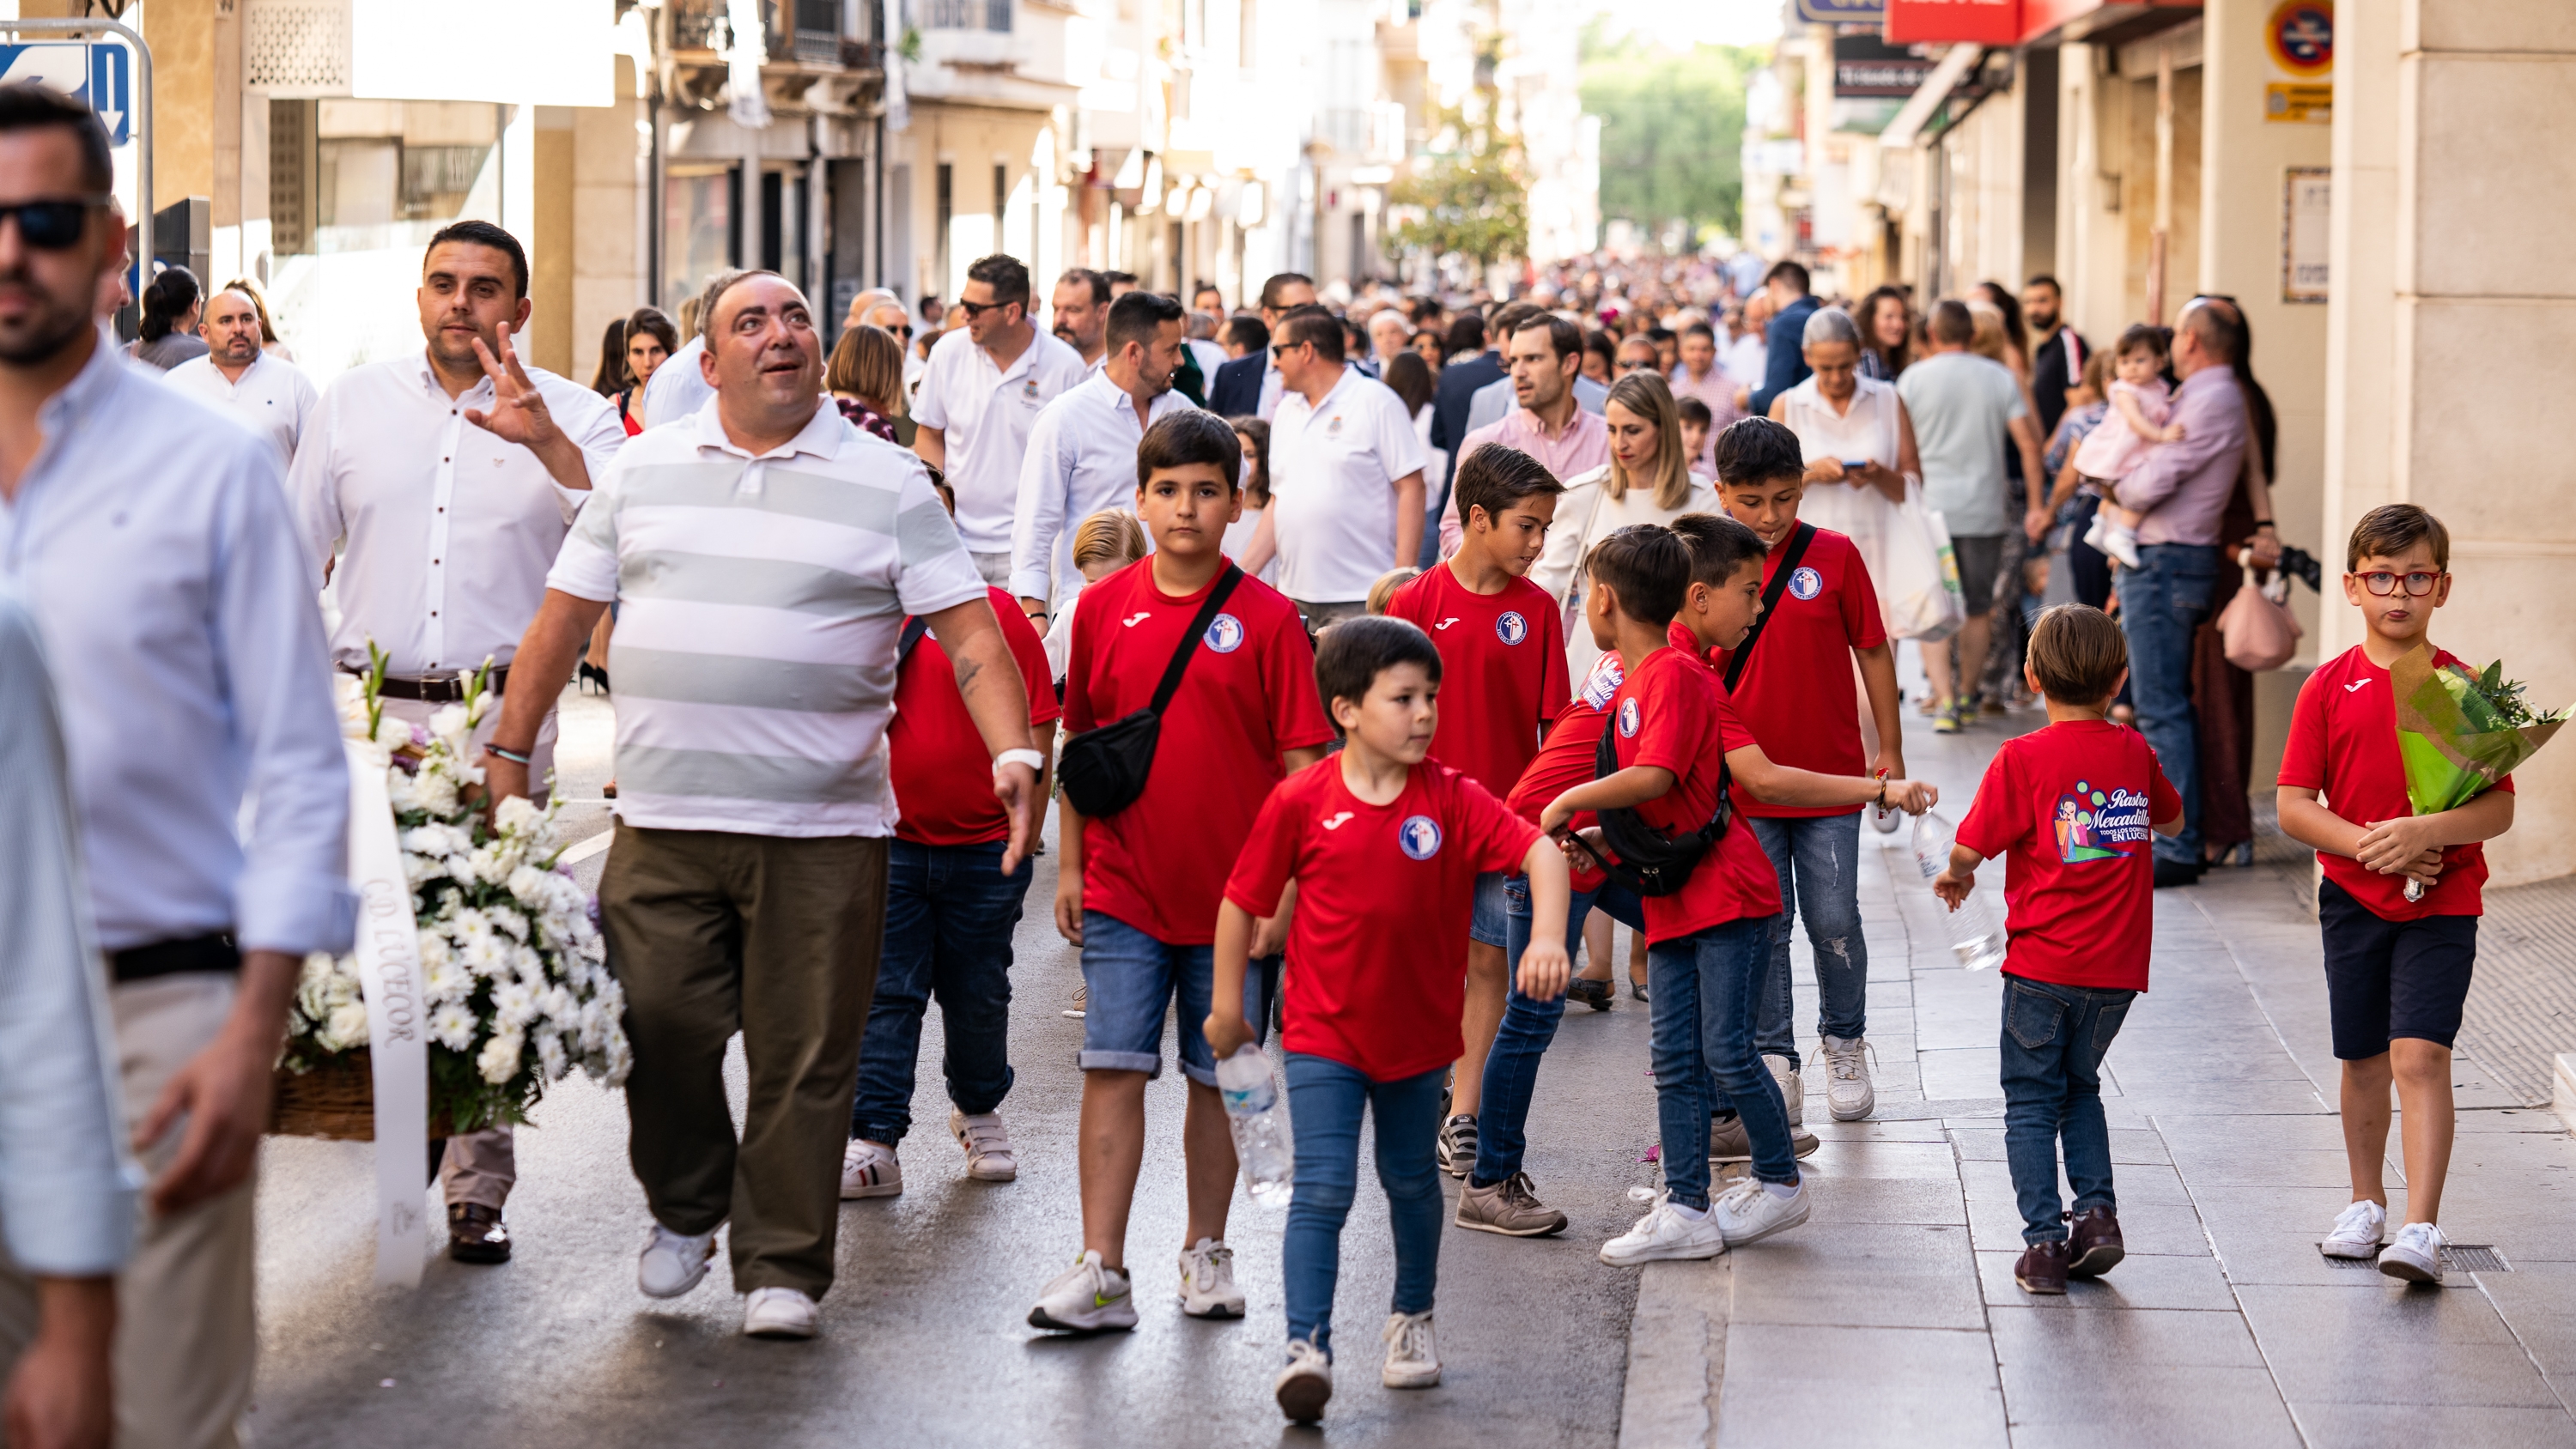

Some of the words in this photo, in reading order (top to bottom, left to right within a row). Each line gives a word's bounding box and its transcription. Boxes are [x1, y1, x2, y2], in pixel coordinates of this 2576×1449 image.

[2107, 788, 2148, 809] Rastro
[2087, 809, 2150, 830] Mercadillo
[375, 929, 416, 1049] LUCECOR
